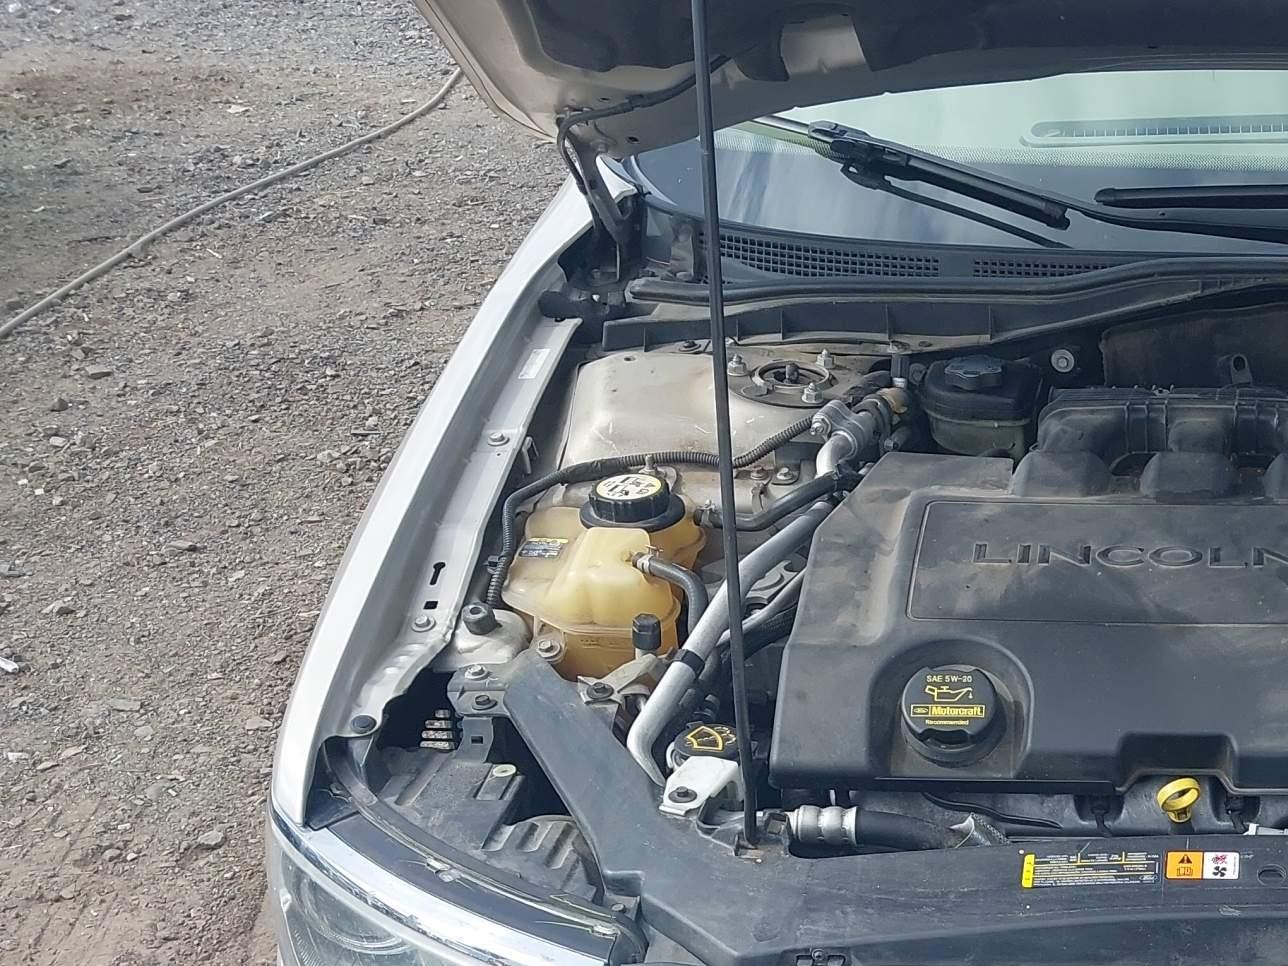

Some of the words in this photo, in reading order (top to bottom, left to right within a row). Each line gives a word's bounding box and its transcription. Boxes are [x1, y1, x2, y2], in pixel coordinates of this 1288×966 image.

[926, 675, 943, 683] SAE
[945, 675, 973, 683] 5W-20
[932, 705, 982, 716] Motorcraft
